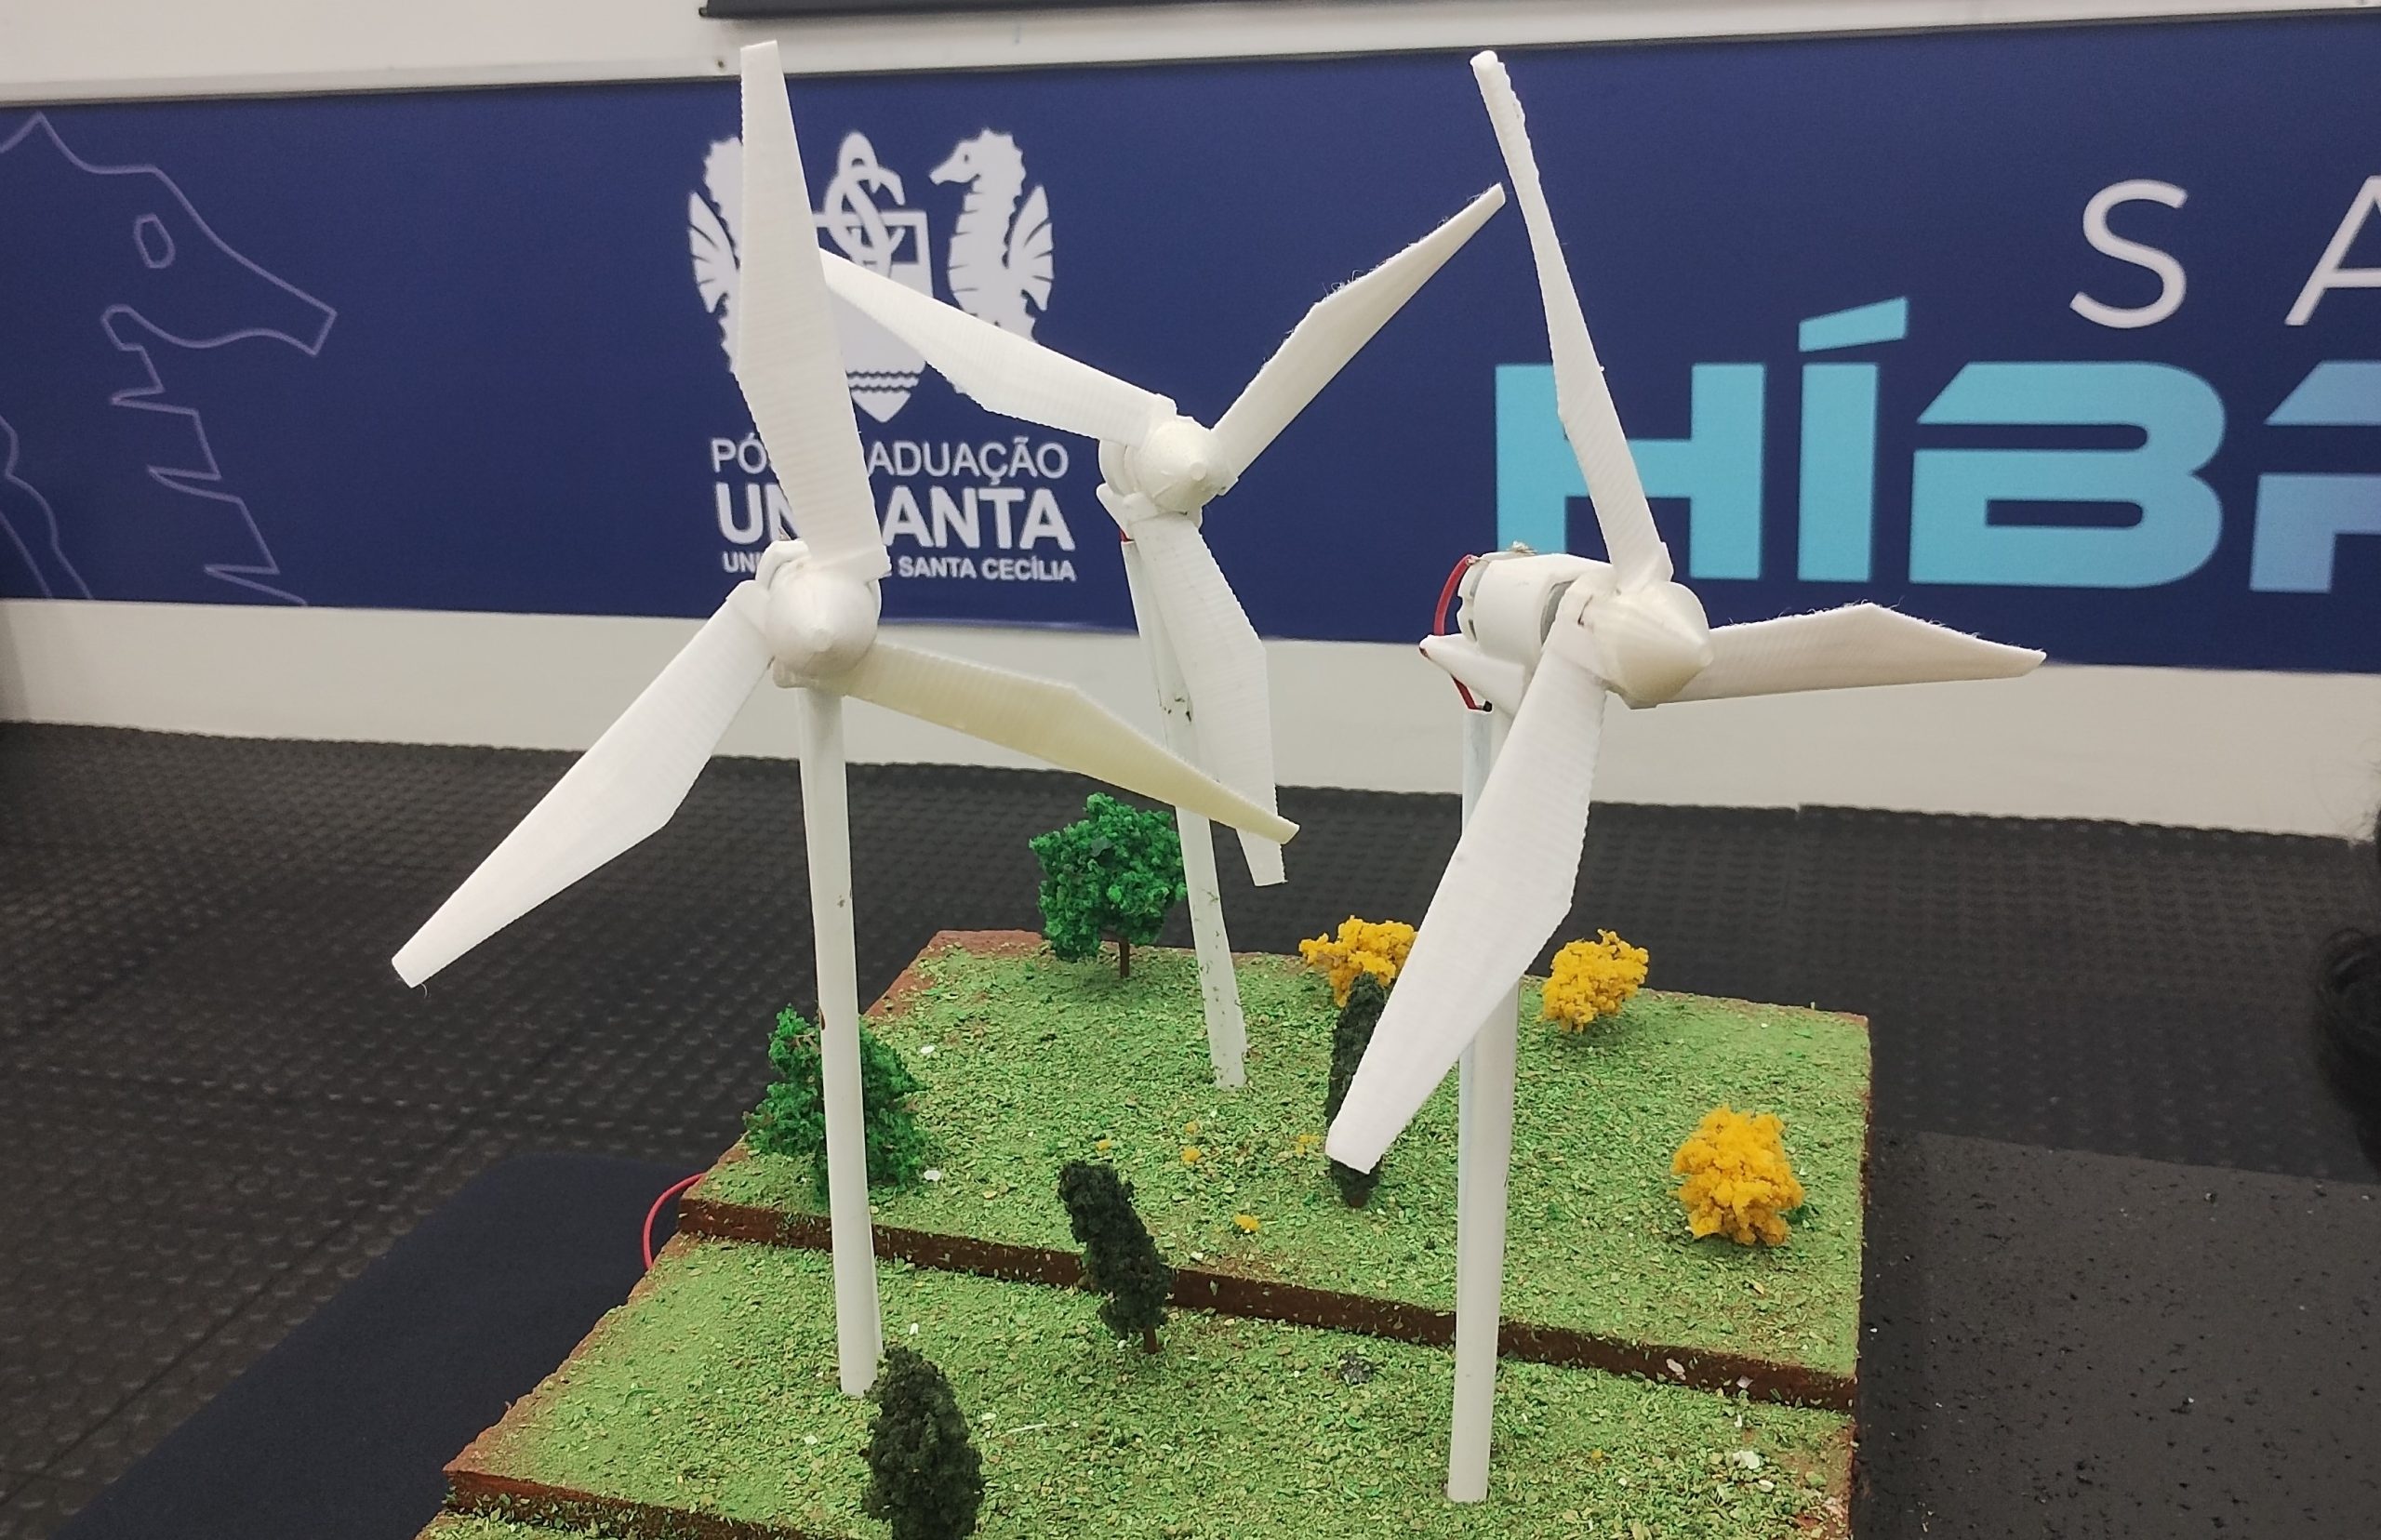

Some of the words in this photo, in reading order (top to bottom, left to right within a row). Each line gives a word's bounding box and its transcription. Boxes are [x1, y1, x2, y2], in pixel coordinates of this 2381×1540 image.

[715, 482, 1076, 551] UNANTA
[898, 557, 978, 578] SANTA
[982, 557, 1077, 582] CECÍLIA
